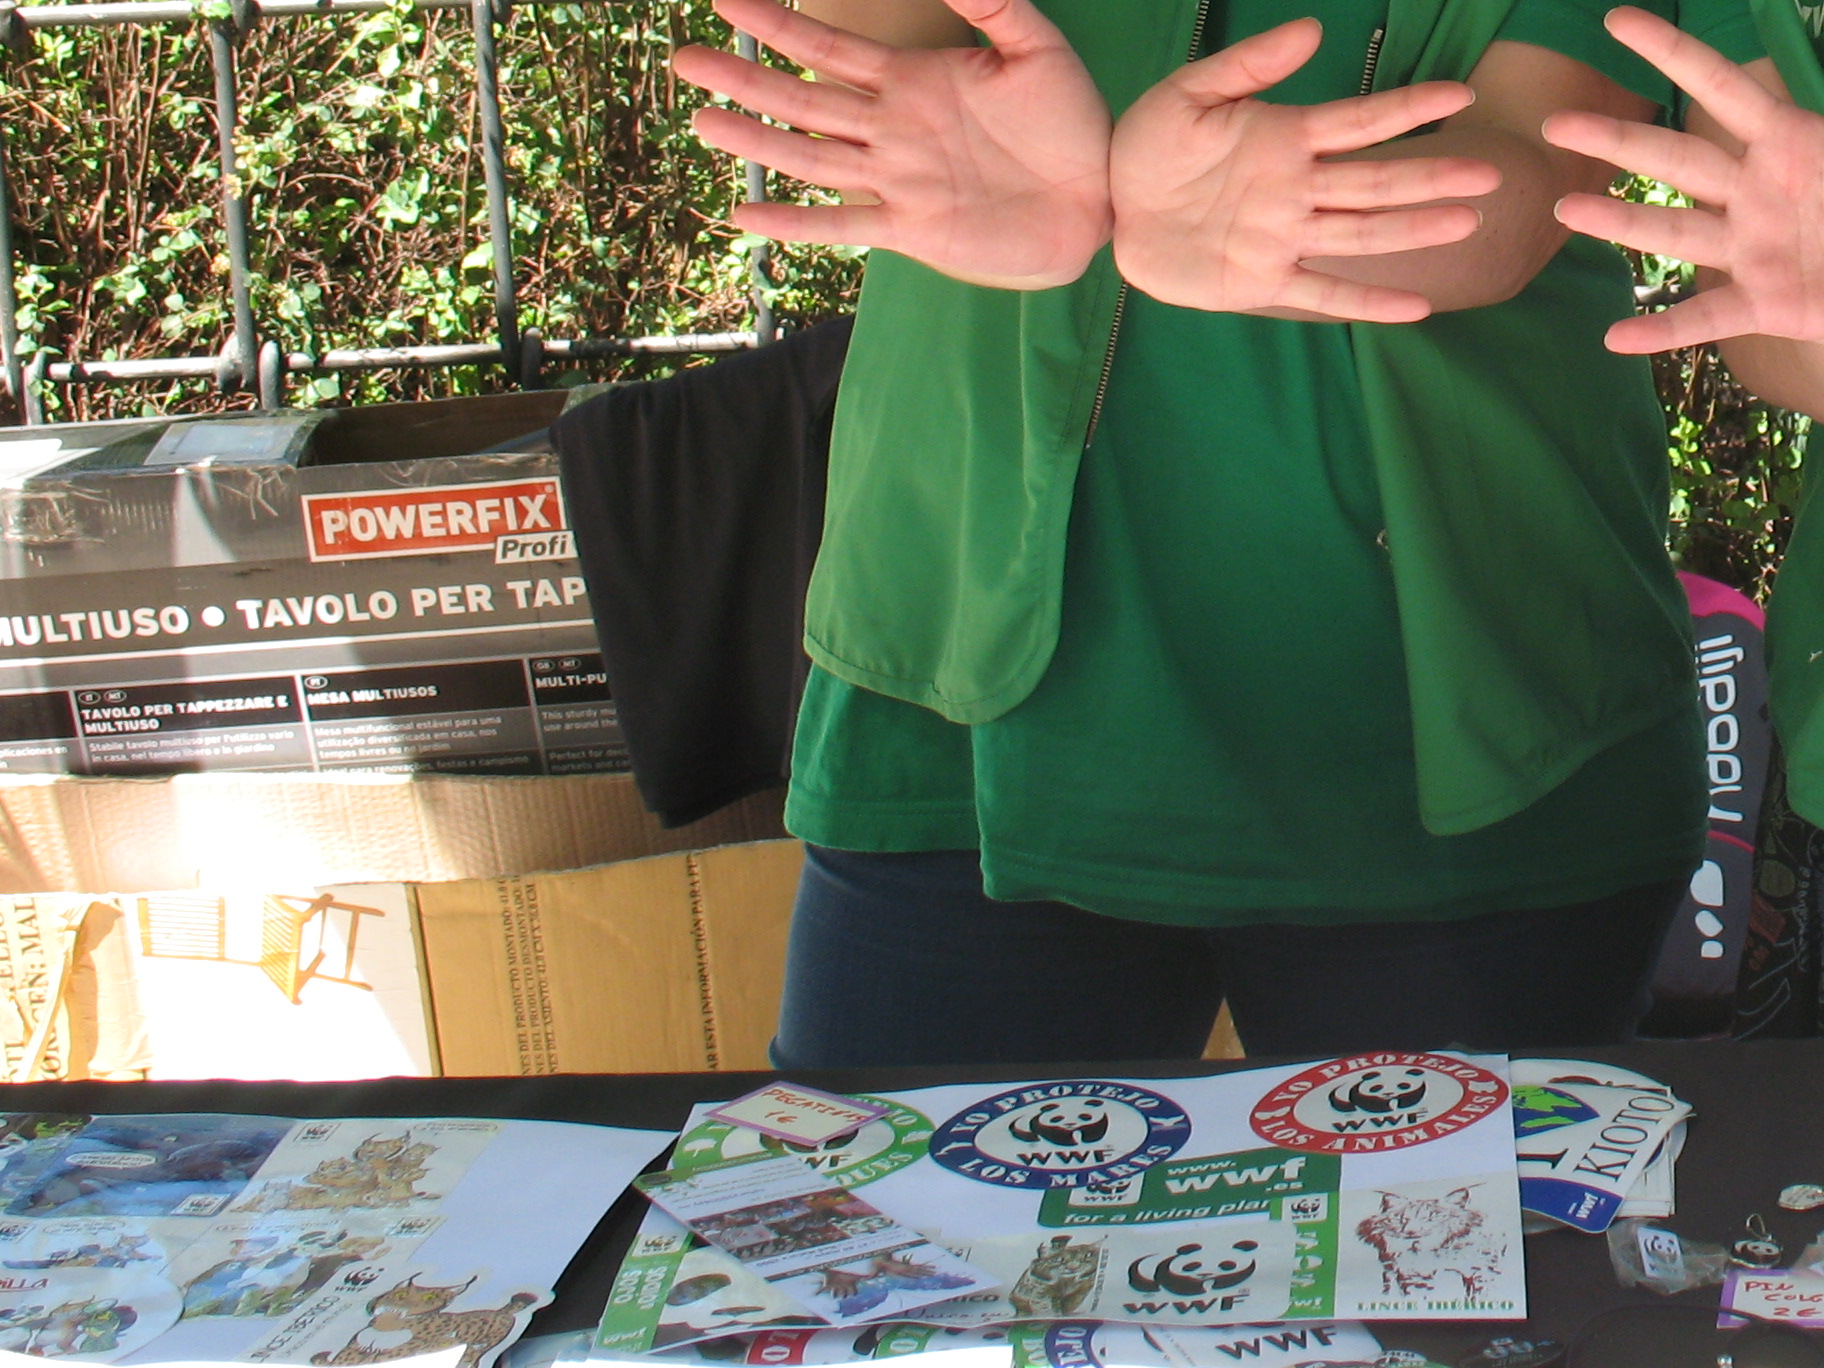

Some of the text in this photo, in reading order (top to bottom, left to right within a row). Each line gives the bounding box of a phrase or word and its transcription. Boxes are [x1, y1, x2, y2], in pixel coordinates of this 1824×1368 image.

[321, 493, 552, 545] POWERFIX
[500, 534, 568, 561] Profi
[236, 590, 398, 630] TAVOLO
[411, 584, 495, 617] PER
[506, 575, 587, 609] TAP
[81, 695, 289, 720] TAVOLO PER TAPPEZZARE E
[307, 685, 437, 705] MESA MULTIUSOS
[85, 718, 160, 733] MULTIUSO
[126, 738, 157, 750] tavolo
[703, 1017, 716, 1050] ESTA
[1272, 1054, 1479, 1103] YO PROTEJO
[994, 1084, 1161, 1112] PROTEJO
[1261, 1095, 1498, 1151] LOS ANIMALES
[1332, 1111, 1429, 1132] WWF
[1573, 1096, 1675, 1182] KIOTO
[958, 1144, 1174, 1187] LOS MARES
[1016, 1148, 1116, 1167] WWF
[1168, 1160, 1236, 1175] www.
[1164, 1156, 1307, 1196] wwf
[1064, 1213, 1106, 1225] for
[1135, 1203, 1211, 1224] living
[1744, 1281, 1794, 1292] PIN
[1123, 1294, 1249, 1315] WWF
[1357, 1300, 1420, 1311] LINCE
[1216, 1326, 1337, 1361] WWF
